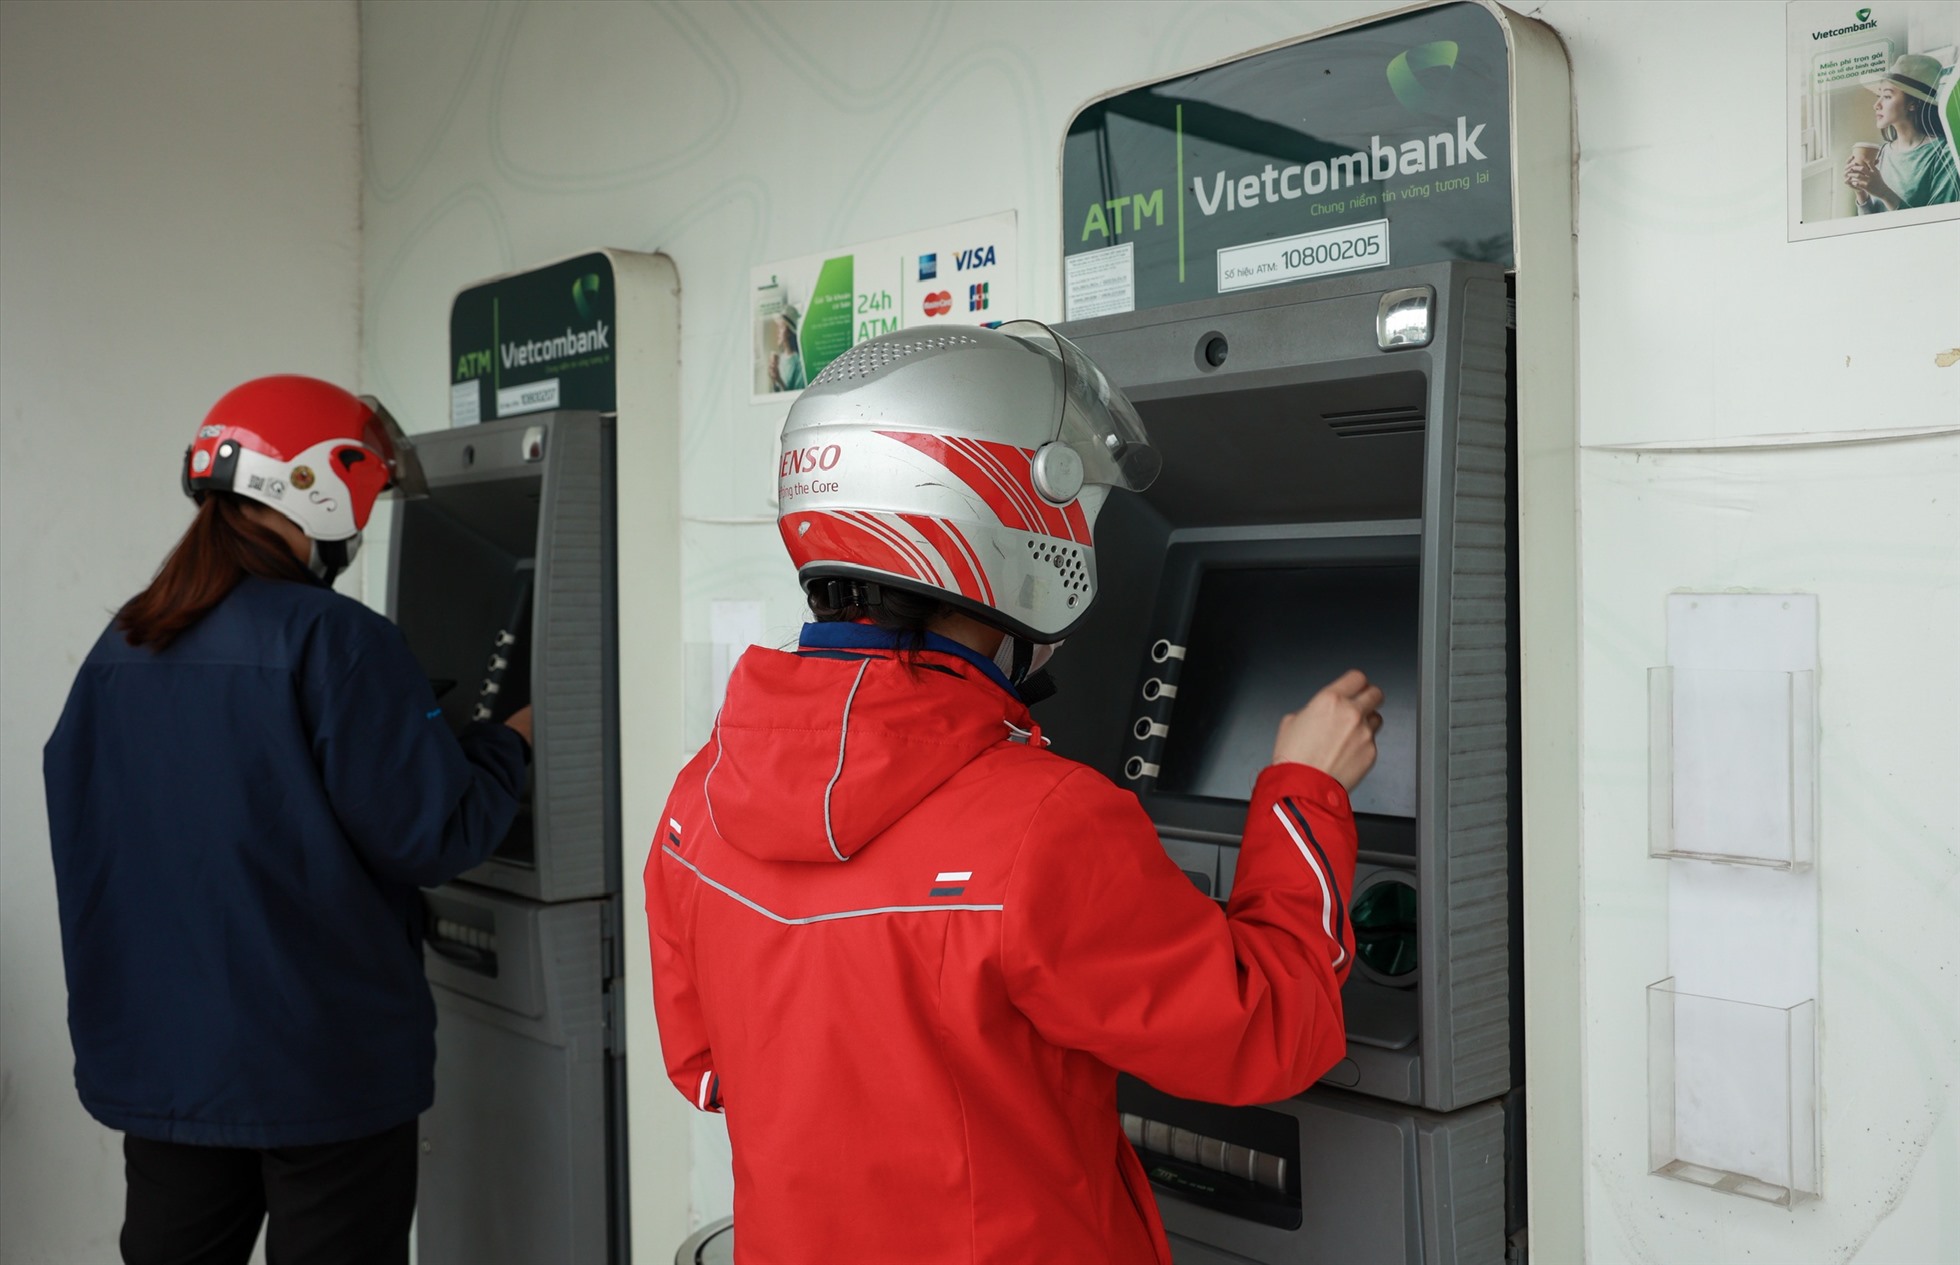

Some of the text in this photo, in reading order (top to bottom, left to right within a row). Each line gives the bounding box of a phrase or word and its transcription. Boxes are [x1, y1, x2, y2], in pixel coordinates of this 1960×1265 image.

[1812, 19, 1878, 40] Vietcombank
[1194, 115, 1487, 216] Vietcombank
[1310, 201, 1345, 216] Chung
[1350, 193, 1377, 209] niềm
[1382, 191, 1396, 203] tin
[1401, 183, 1430, 199] vững
[1476, 170, 1490, 184] lai
[1081, 189, 1164, 241] ATM
[952, 245, 996, 272] VISA
[1224, 267, 1235, 280] Số
[1256, 262, 1278, 275] ATM:
[1281, 235, 1380, 270] 10800205
[857, 290, 892, 315] 24h
[501, 319, 609, 369] Vietcombank
[857, 316, 897, 342] ATM
[456, 350, 492, 380] ATM
[780, 444, 842, 478] ENSO
[794, 482, 809, 495] the
[811, 480, 839, 493] Core
